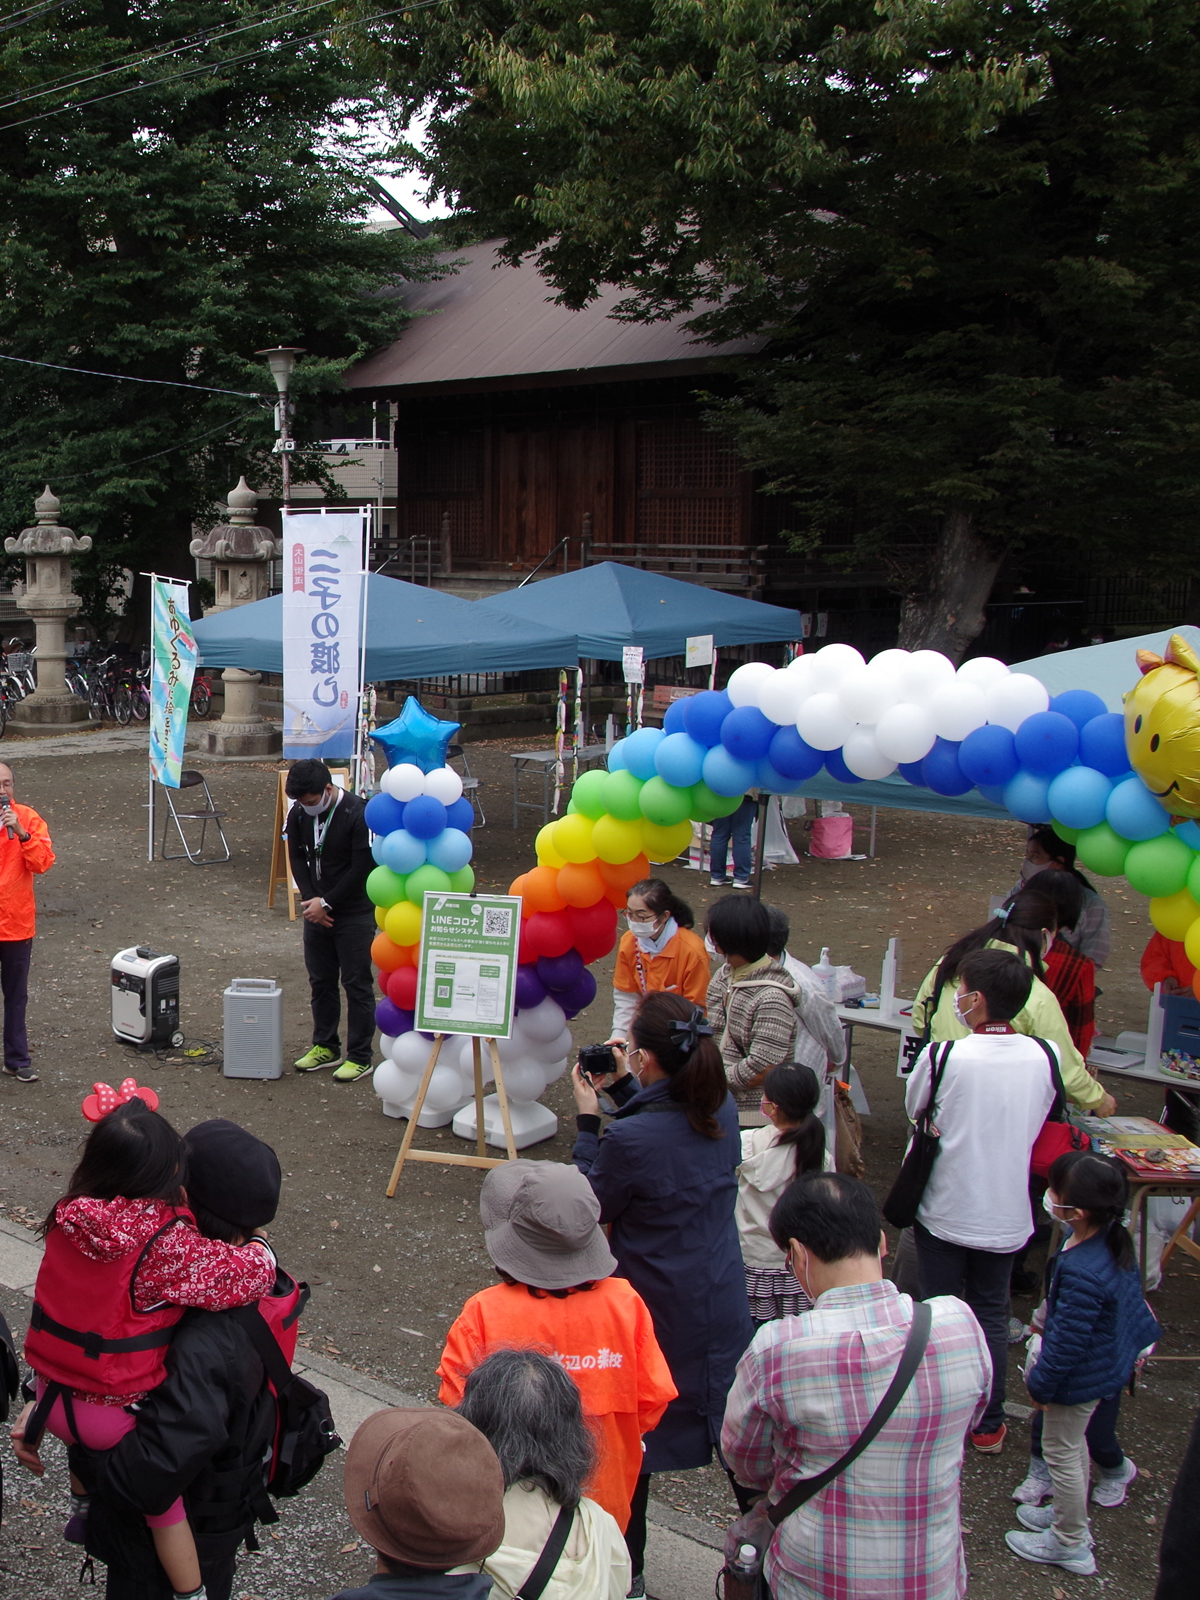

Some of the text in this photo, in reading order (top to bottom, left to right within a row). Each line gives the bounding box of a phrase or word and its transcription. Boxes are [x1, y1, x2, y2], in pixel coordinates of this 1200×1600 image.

[431, 915, 478, 926] LINEコロナ
[430, 926, 479, 935] お知らせシステム
